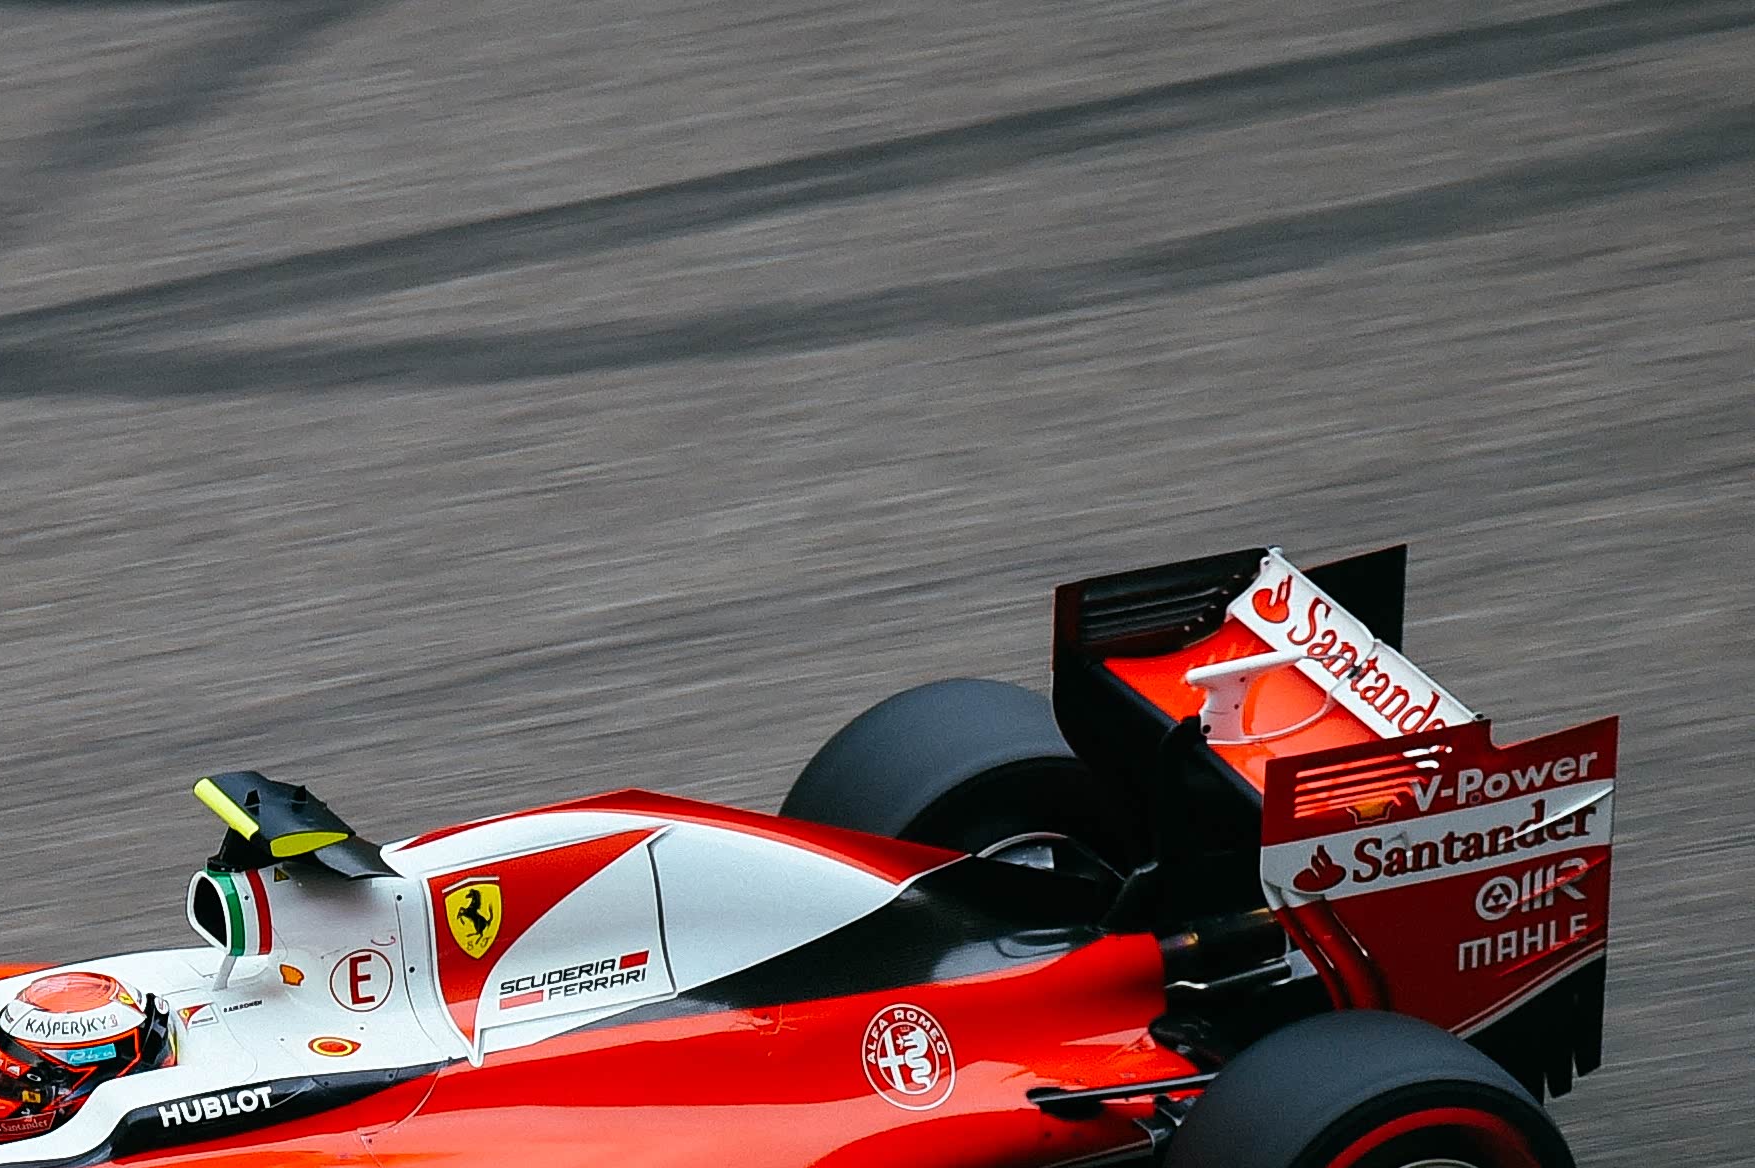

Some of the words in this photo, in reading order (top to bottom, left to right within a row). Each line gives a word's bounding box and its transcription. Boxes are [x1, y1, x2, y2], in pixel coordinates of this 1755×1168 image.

[1411, 752, 1598, 812] V-Power
[1352, 799, 1597, 884] Santander
[1458, 913, 1588, 972] MAHLE
[349, 954, 375, 1005] E
[499, 958, 617, 996] SCUDERIA
[547, 968, 646, 1001] FERRARI
[25, 1016, 107, 1038] KASPERSKY
[866, 1018, 889, 1065] ALFA
[893, 1009, 947, 1055] ROMEO
[1, 1118, 49, 1133] Santander
[158, 1086, 273, 1128] HUBLOT
